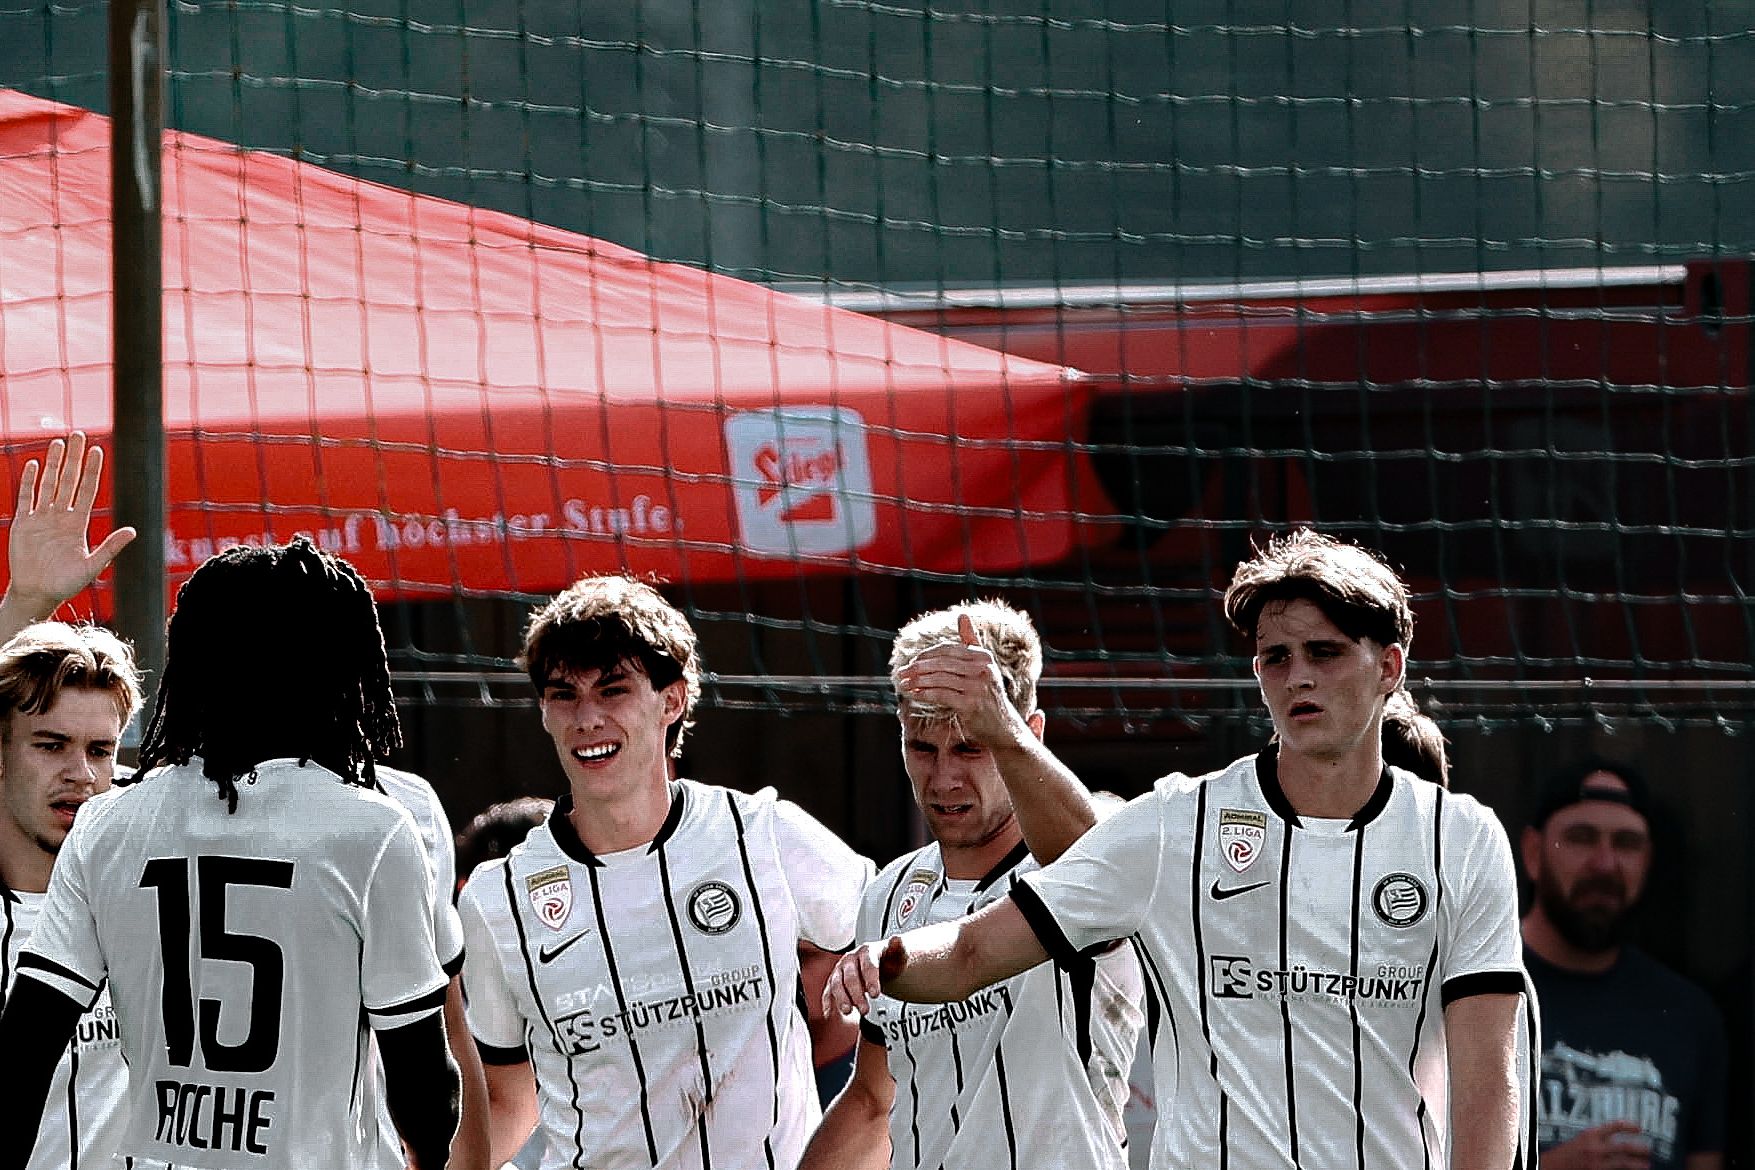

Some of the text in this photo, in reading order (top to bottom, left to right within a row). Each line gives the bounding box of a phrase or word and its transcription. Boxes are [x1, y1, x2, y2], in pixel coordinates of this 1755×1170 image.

[138, 855, 295, 1075] 15
[1256, 965, 1423, 1001] STÜTZPUNKT
[600, 977, 763, 1038] STÜTZPUNKT
